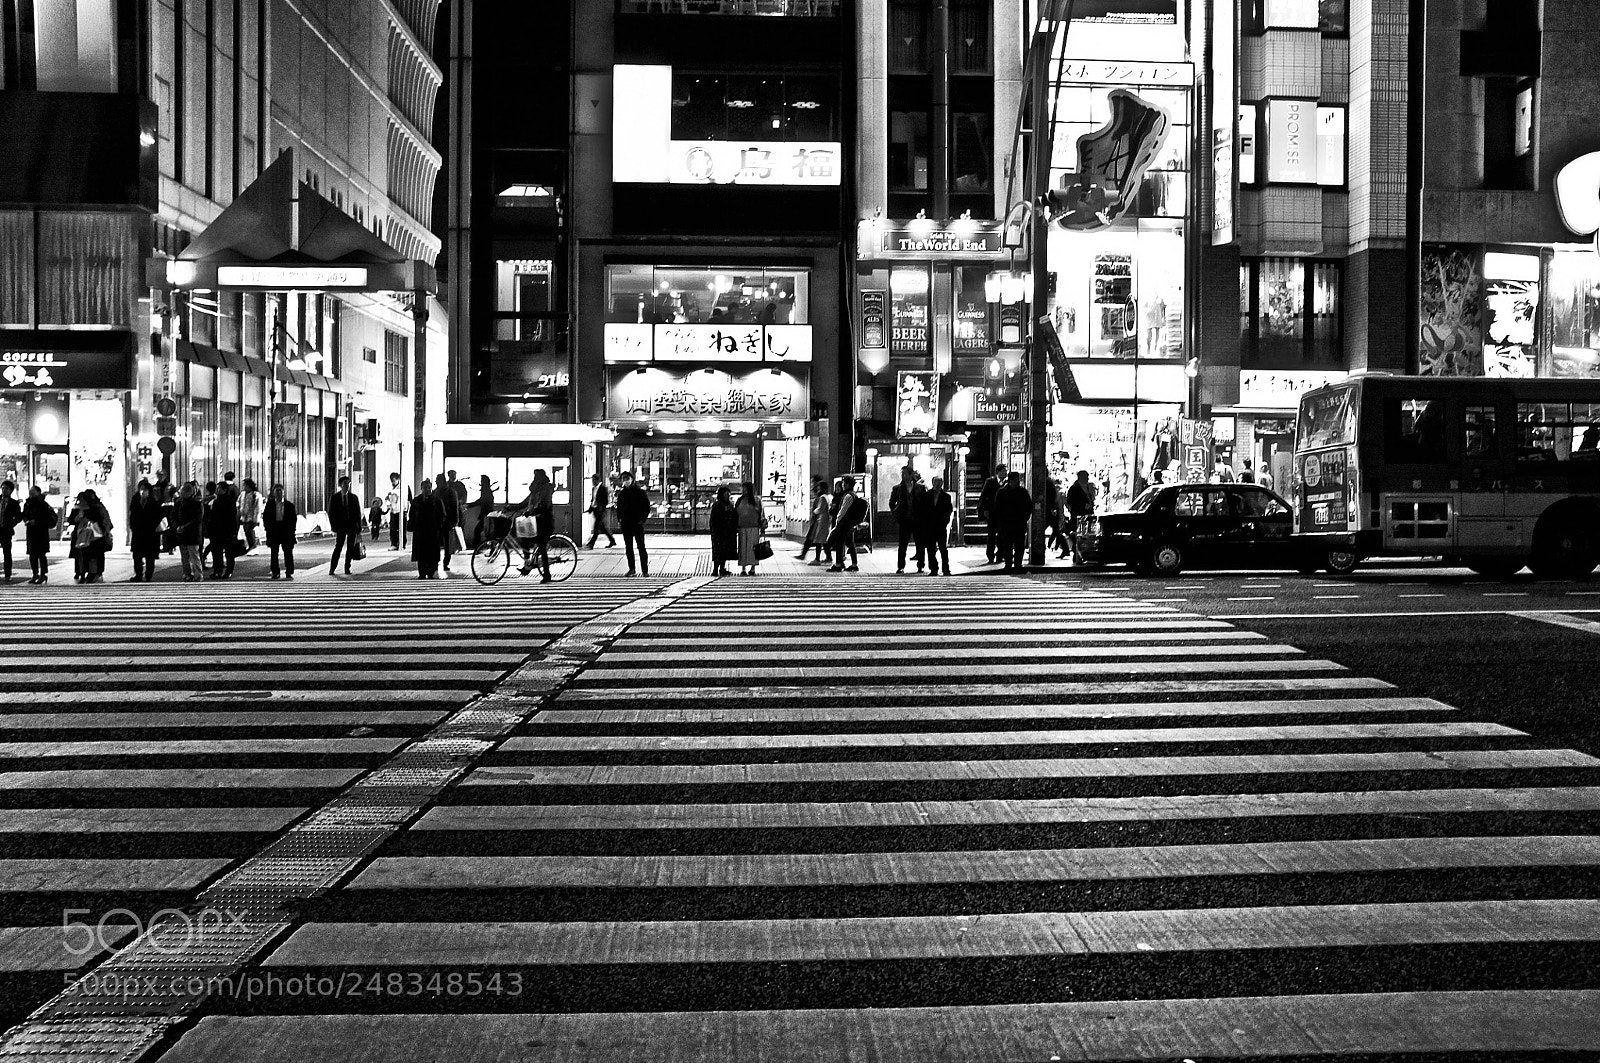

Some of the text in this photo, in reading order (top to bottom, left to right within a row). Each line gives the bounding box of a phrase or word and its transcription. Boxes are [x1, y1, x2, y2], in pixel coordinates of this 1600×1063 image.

[1287, 104, 1300, 165] PROMISE
[963, 239, 987, 251] End
[892, 328, 926, 340] BEER
[709, 330, 790, 357] ねぎし
[3, 353, 53, 362] COFFEE
[977, 403, 1017, 412] Irish Pub
[996, 413, 1016, 421] OPEN
